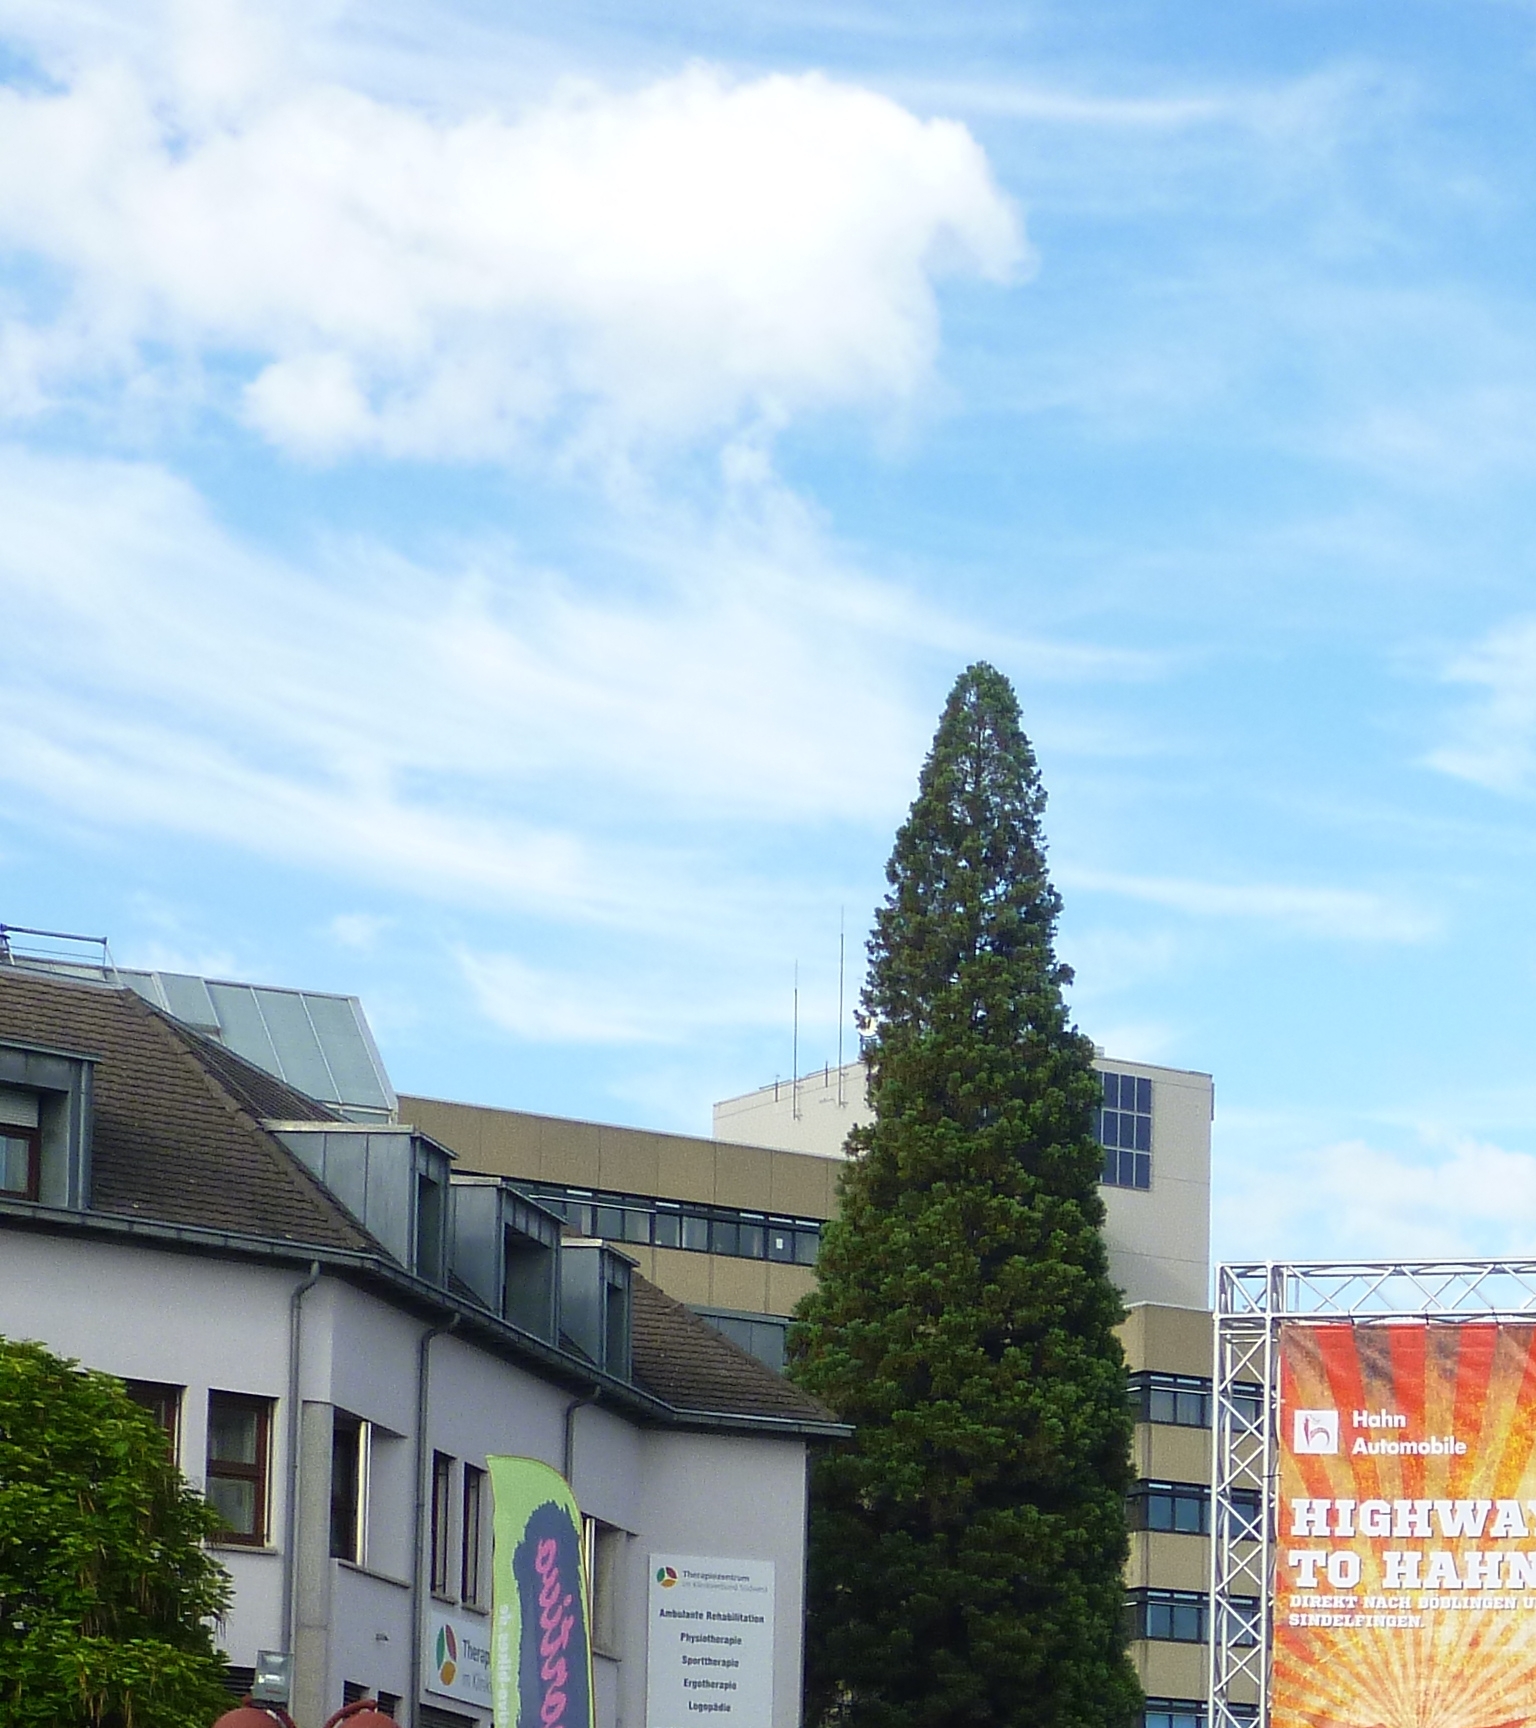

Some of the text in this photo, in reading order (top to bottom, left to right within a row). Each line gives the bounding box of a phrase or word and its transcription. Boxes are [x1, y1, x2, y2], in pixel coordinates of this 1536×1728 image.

[1352, 1410, 1407, 1428] Hahn
[1352, 1436, 1467, 1455] Automobile
[682, 1570, 750, 1582] Therapiezentrum
[1289, 1550, 1361, 1589] TO
[1289, 1595, 1358, 1609] DIREKT
[1363, 1596, 1411, 1609] NACH
[1418, 1595, 1517, 1610] BÖBLINGEN
[659, 1608, 765, 1623] Ambulante Rehabilitation
[680, 1632, 742, 1646] Physiotherapie
[682, 1655, 740, 1668] Sporttherapie
[683, 1678, 737, 1691] Ergotherapie
[688, 1701, 731, 1713] Logopädie
